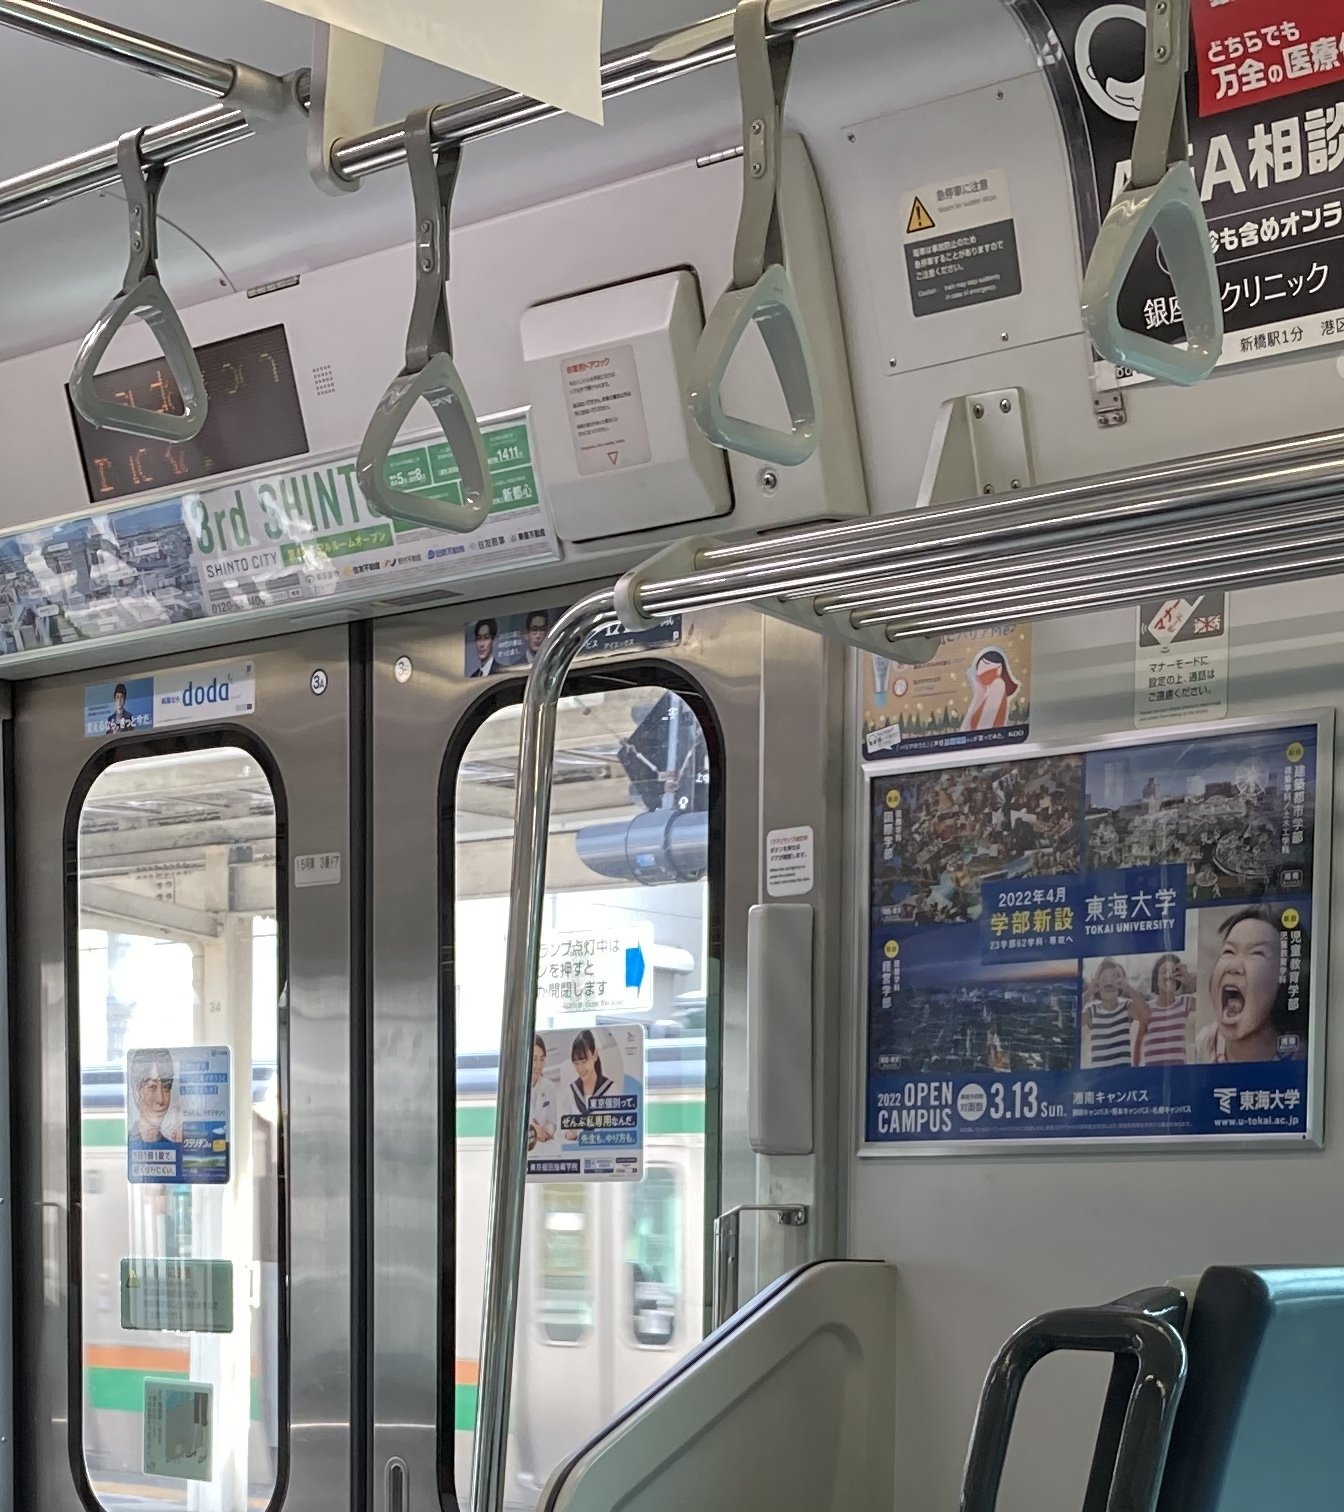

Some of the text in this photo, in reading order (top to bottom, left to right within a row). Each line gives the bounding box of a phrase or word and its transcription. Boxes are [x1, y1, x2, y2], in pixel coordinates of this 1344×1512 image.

[1207, 21, 1300, 63] どちらでも
[1239, 325, 1304, 352] 新橋駅1分
[196, 463, 384, 554] 3rd SHINT
[206, 551, 278, 579] SHINTO CITY
[1149, 655, 1209, 672] マナーモードに
[182, 676, 230, 707] doda
[1148, 669, 1215, 689] 設定の上、通話は
[998, 886, 1067, 908] 2022年4月
[1084, 888, 1177, 923] 東海大学
[991, 907, 1074, 937] 学部新設
[1085, 919, 1176, 936] TOKAI UNIVERSITY
[1288, 930, 1303, 1012] 児童教育学部
[209, 1001, 222, 1013] 34
[877, 1081, 954, 1107] 2022 OPEN
[989, 1081, 1068, 1120] 3.13 Sun.
[1072, 1088, 1150, 1105] 湘南キャンパス
[1239, 1088, 1301, 1111] 東海大学
[877, 1107, 953, 1134] CAMPUS
[1213, 1115, 1300, 1127] www.u-tokai.ac.jp
